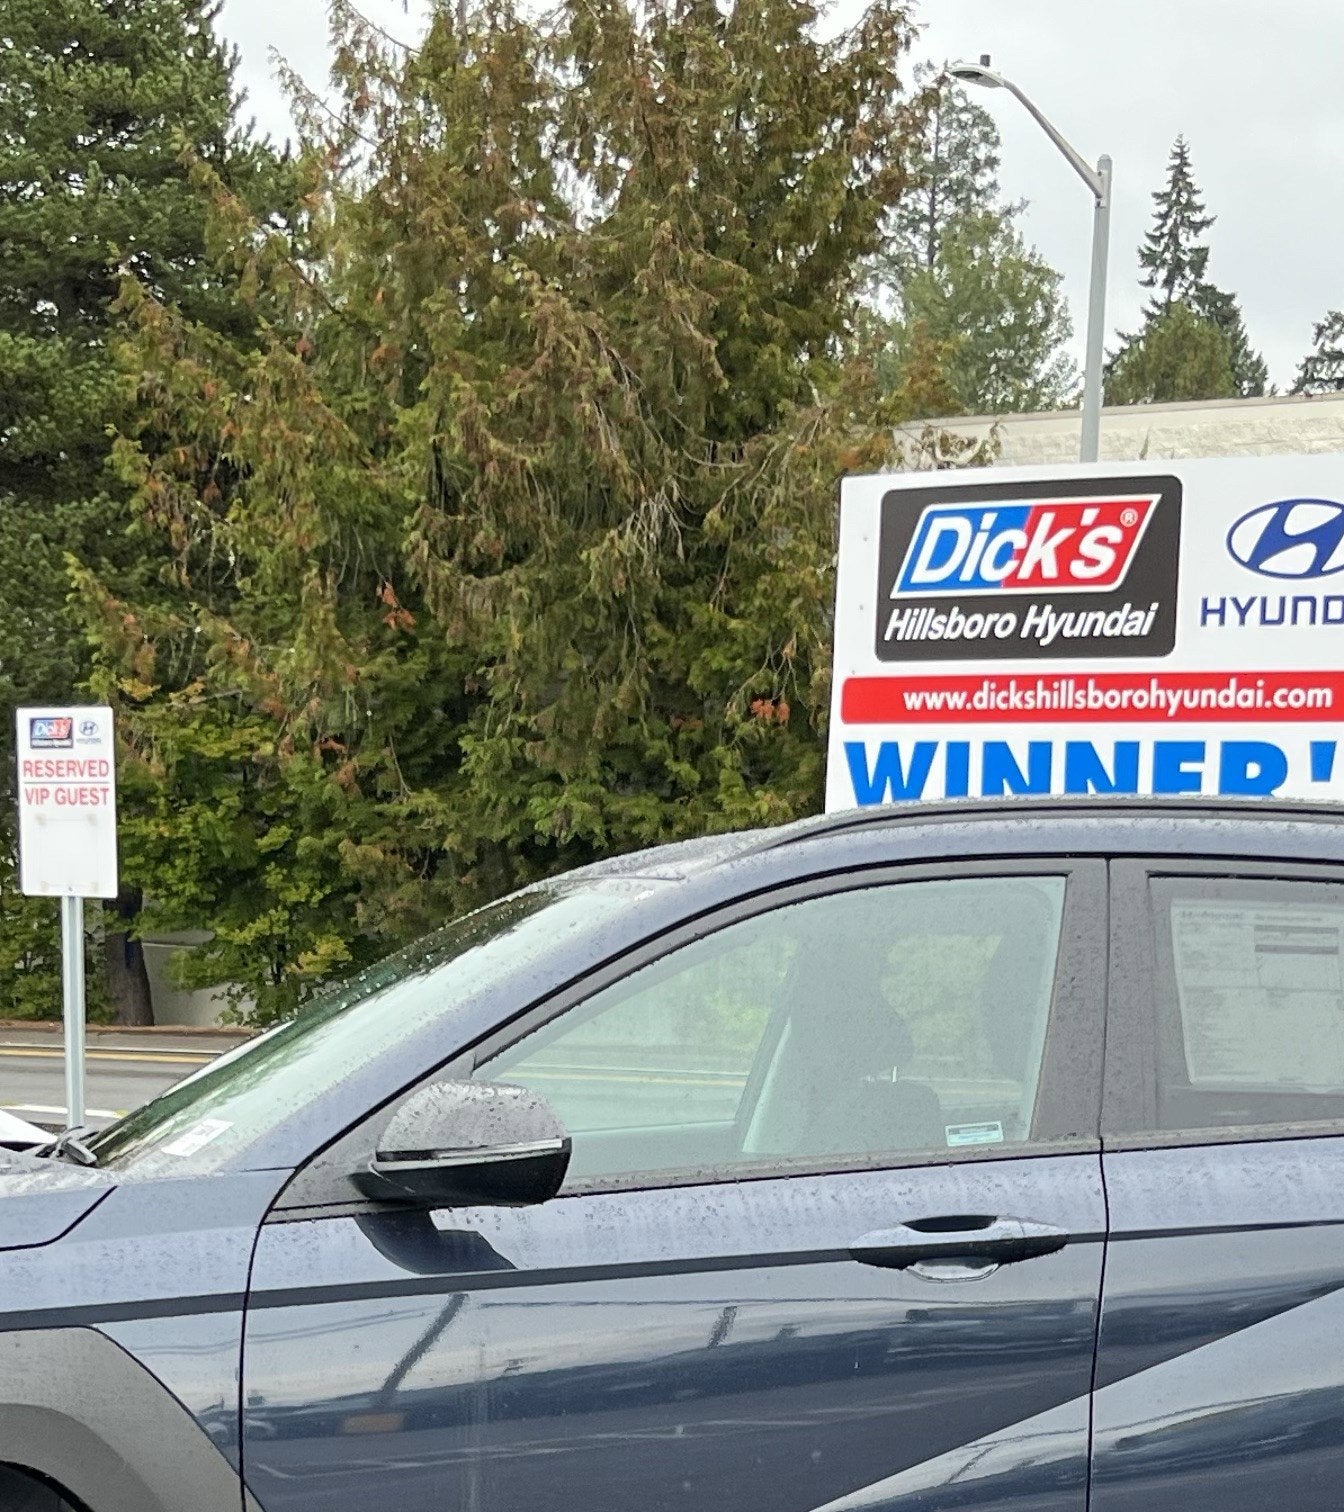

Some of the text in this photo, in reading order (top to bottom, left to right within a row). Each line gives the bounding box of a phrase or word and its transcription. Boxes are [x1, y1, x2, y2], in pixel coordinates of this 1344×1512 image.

[884, 602, 1159, 647] Hillsboro Hyundai
[903, 679, 1333, 717] www.dickshillsborohyundai.com
[23, 760, 110, 778] RESERVED
[25, 788, 110, 806] VIP GUEST
